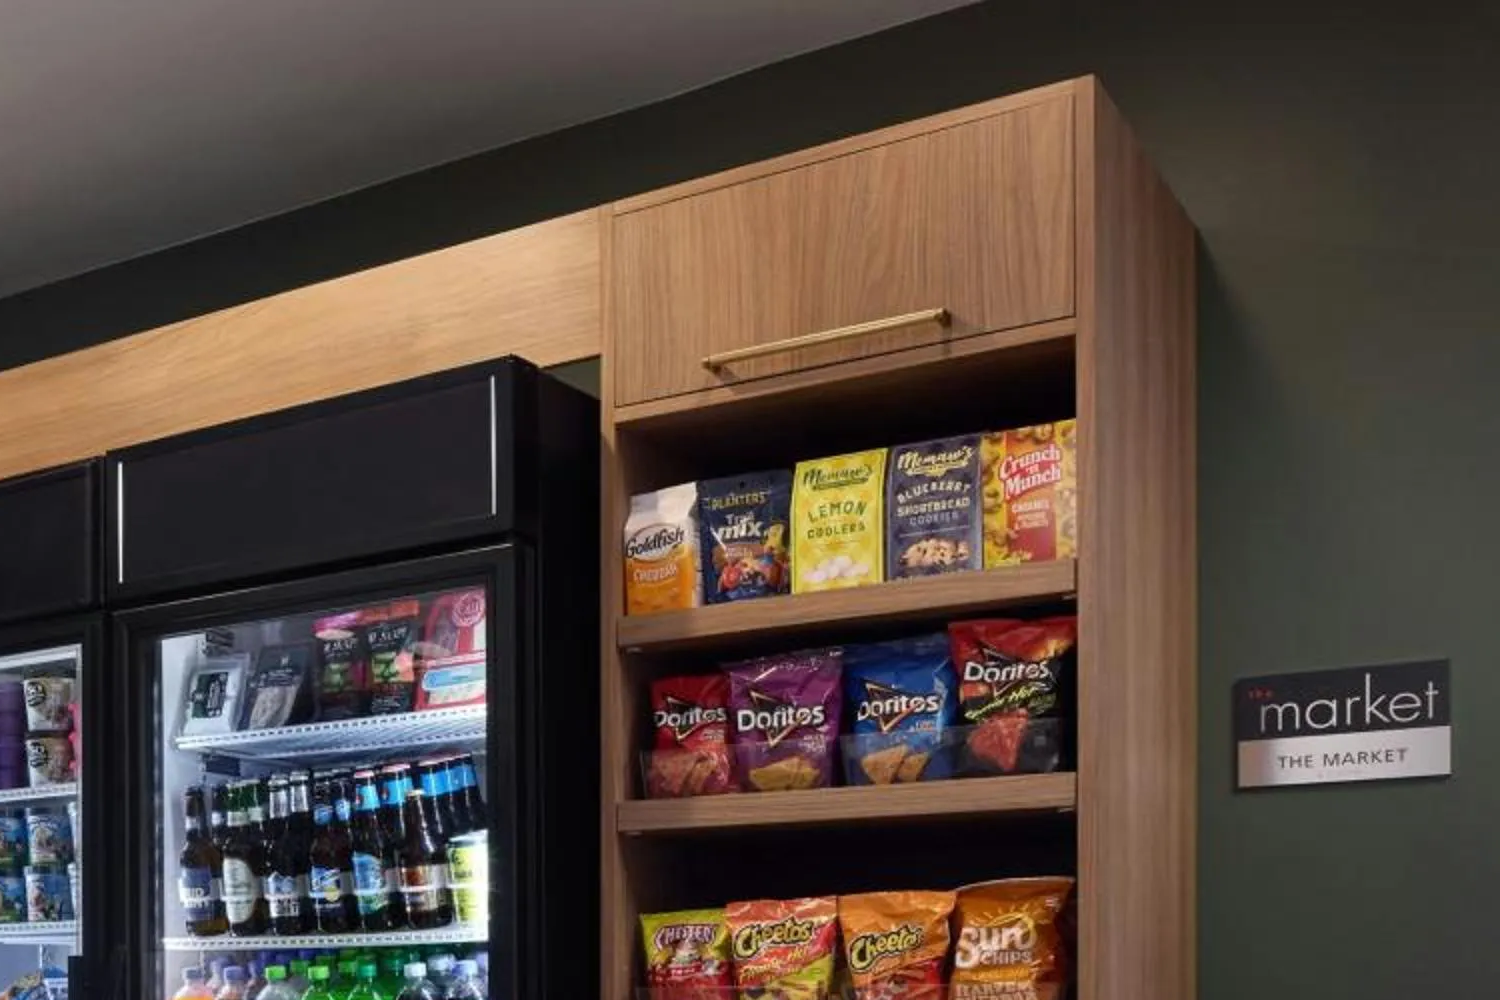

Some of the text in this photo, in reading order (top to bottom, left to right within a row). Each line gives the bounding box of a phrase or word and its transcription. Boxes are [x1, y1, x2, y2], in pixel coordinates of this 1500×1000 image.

[1001, 445, 1060, 479] Crunch
[897, 481, 971, 503] BLUEBERRY
[1005, 467, 1061, 497] Munch
[807, 501, 868, 523] LEMON
[897, 497, 971, 516] SHORTBREAD
[625, 525, 686, 559] Goldfish
[718, 521, 763, 540] mix
[964, 660, 1051, 683] Doritos
[857, 694, 941, 721] Doritos
[1260, 672, 1439, 733] market
[654, 706, 728, 728] Doritos
[738, 705, 825, 732] Doritos
[1276, 747, 1410, 769] THE MARKET
[733, 918, 814, 959] Cheetos
[955, 922, 1036, 969] Sun
[980, 950, 1032, 966] CHIPS
[956, 981, 1035, 997] HARVEST
